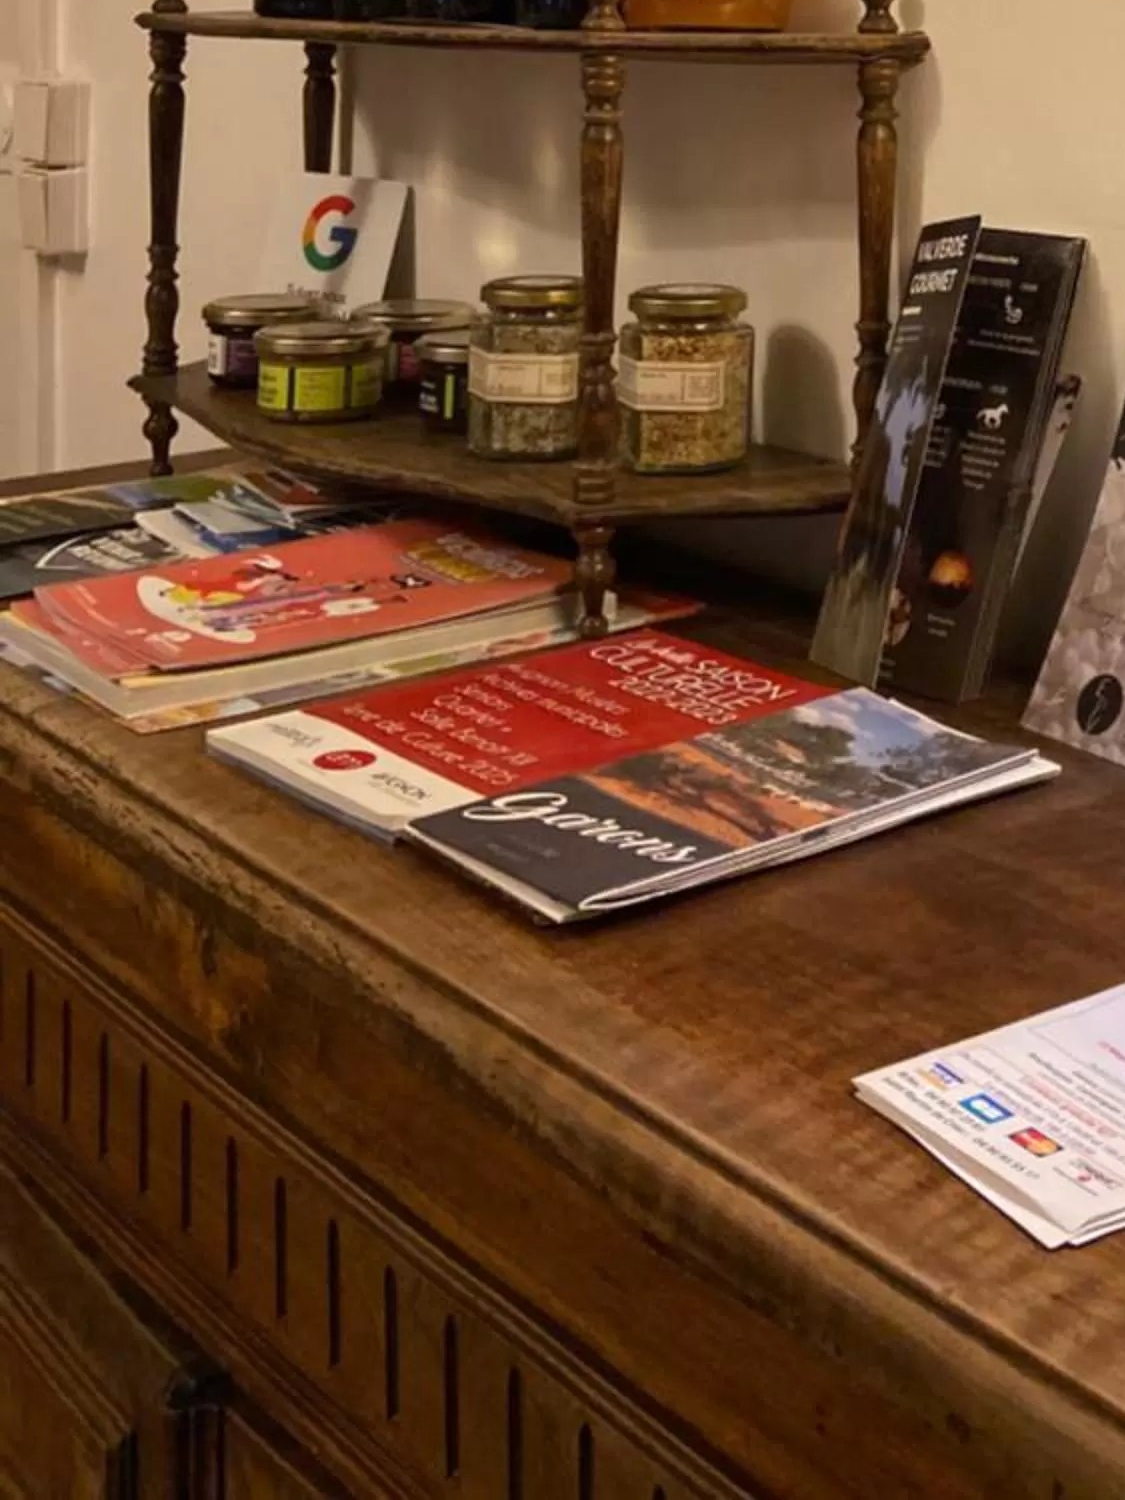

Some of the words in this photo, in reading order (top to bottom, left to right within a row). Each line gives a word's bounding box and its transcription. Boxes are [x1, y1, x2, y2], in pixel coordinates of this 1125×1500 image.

[302, 194, 358, 272] G
[589, 645, 764, 710] CULTURELLE
[682, 660, 797, 700] SAISON
[461, 790, 698, 865] Garons
